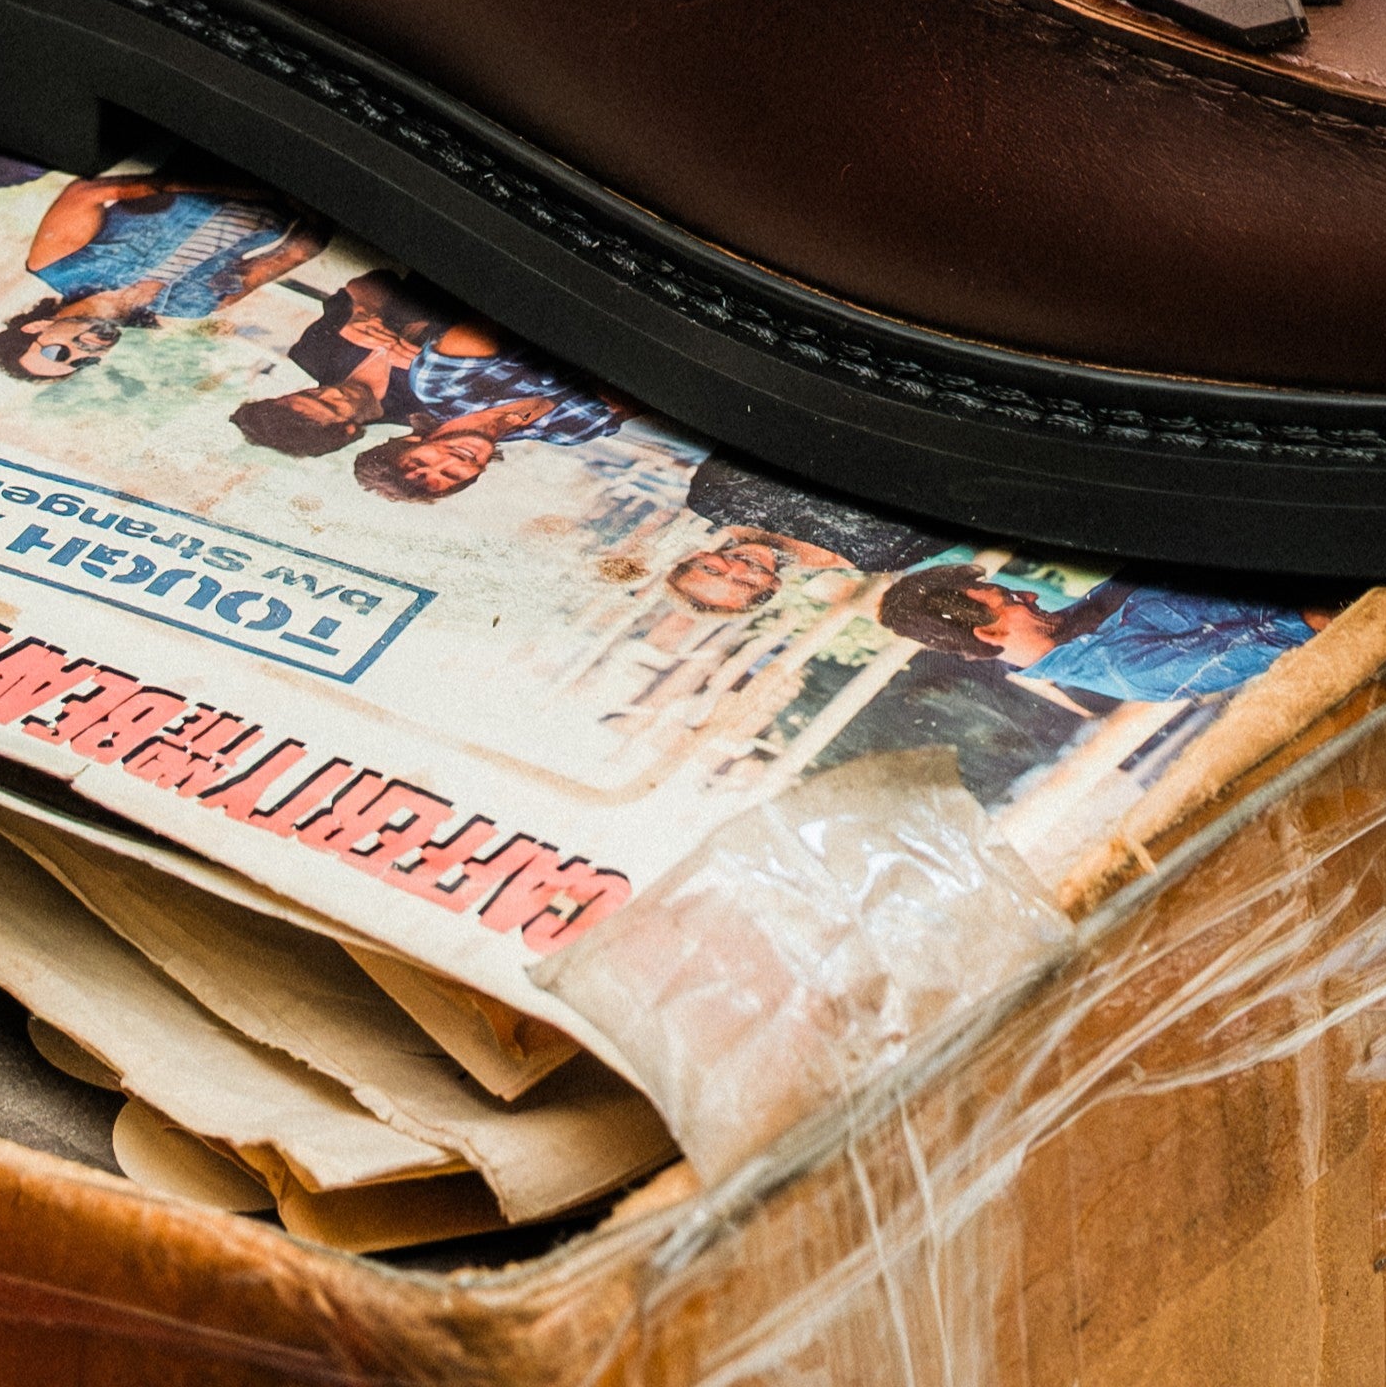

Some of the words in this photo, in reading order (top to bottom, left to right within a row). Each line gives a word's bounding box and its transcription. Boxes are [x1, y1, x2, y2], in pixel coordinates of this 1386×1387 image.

[6, 522, 343, 657] TOUGH
[263, 563, 383, 617] b/w
[161, 702, 266, 768] THE
[198, 736, 633, 957] CAFFERTY
